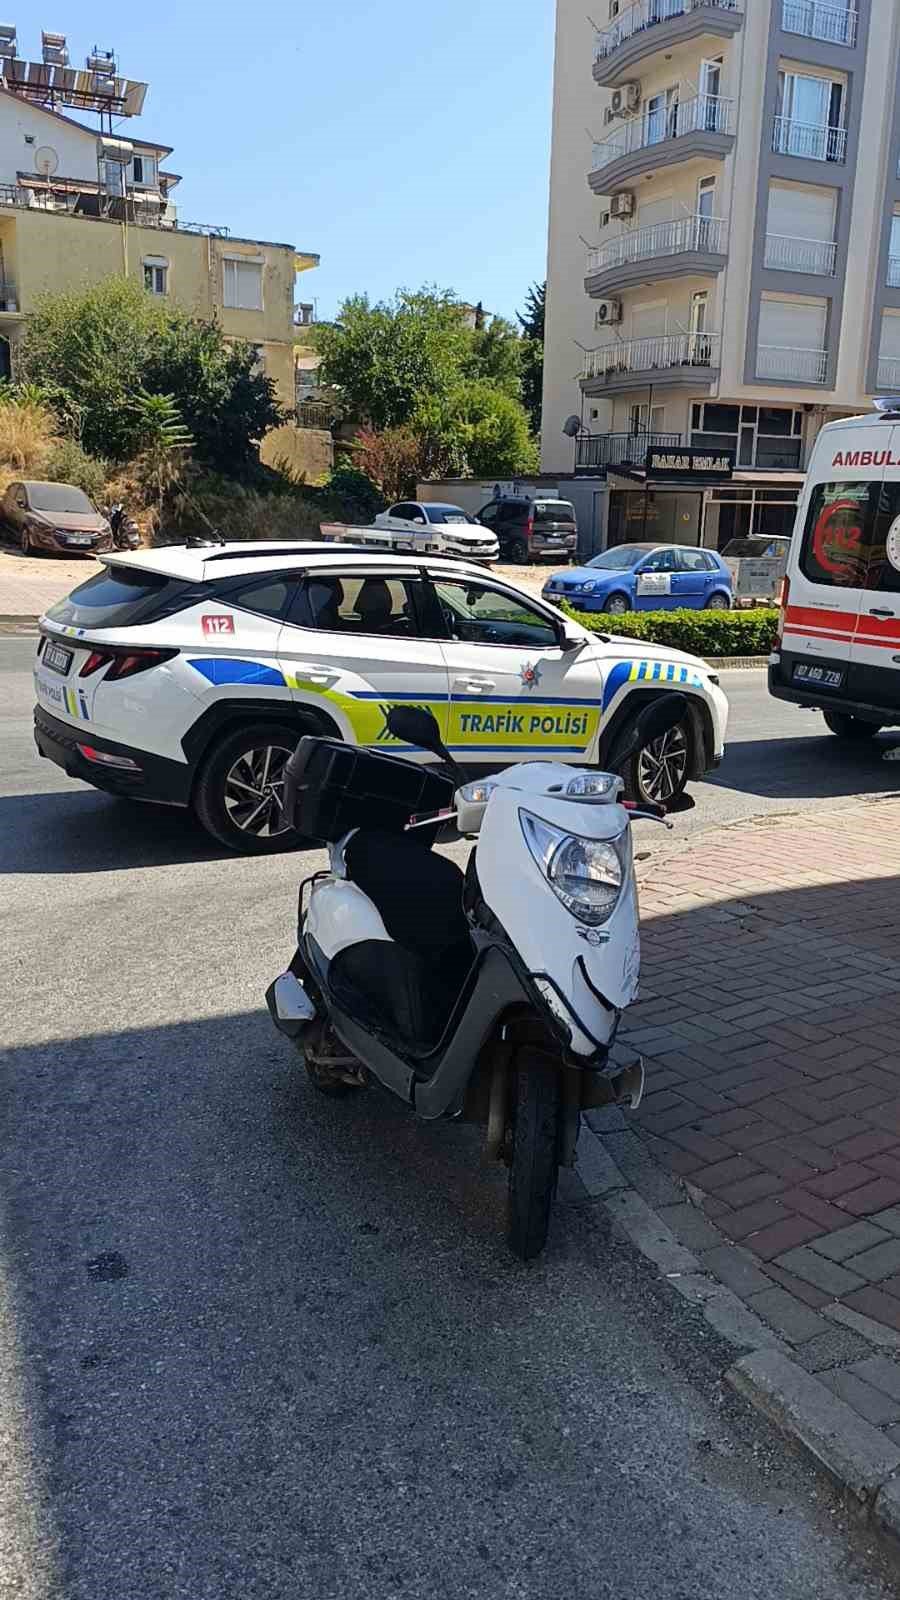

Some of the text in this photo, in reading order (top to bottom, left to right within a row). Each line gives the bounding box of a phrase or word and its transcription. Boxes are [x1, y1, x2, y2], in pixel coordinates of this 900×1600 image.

[832, 451, 900, 466] AMBUL
[823, 526, 862, 550] 112
[206, 617, 229, 633] 112
[460, 710, 589, 735] TRAFİK POLİSİ
